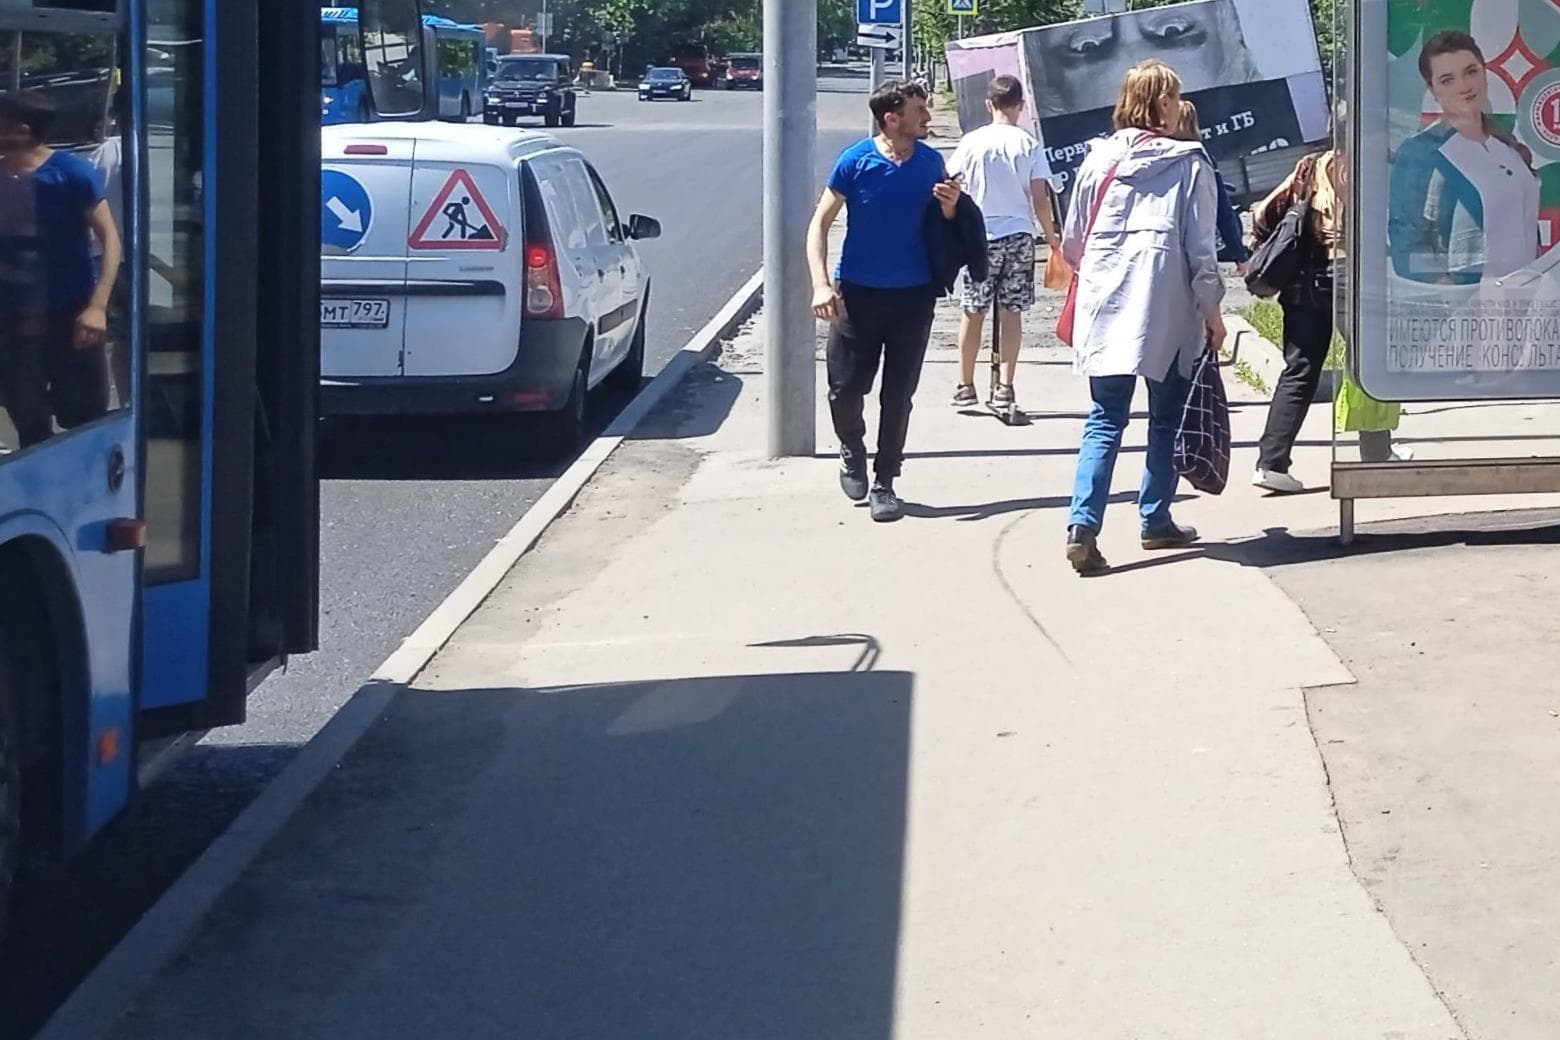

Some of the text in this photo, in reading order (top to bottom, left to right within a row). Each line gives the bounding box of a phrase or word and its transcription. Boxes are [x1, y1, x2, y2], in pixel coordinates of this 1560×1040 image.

[1215, 122, 1230, 136] и
[1230, 110, 1255, 131] ГБ
[353, 302, 384, 317] 797
[1389, 318, 1457, 342] ИМЕЮТСЯ
[1389, 344, 1473, 368] ПОЛУЧЕНИЕ
